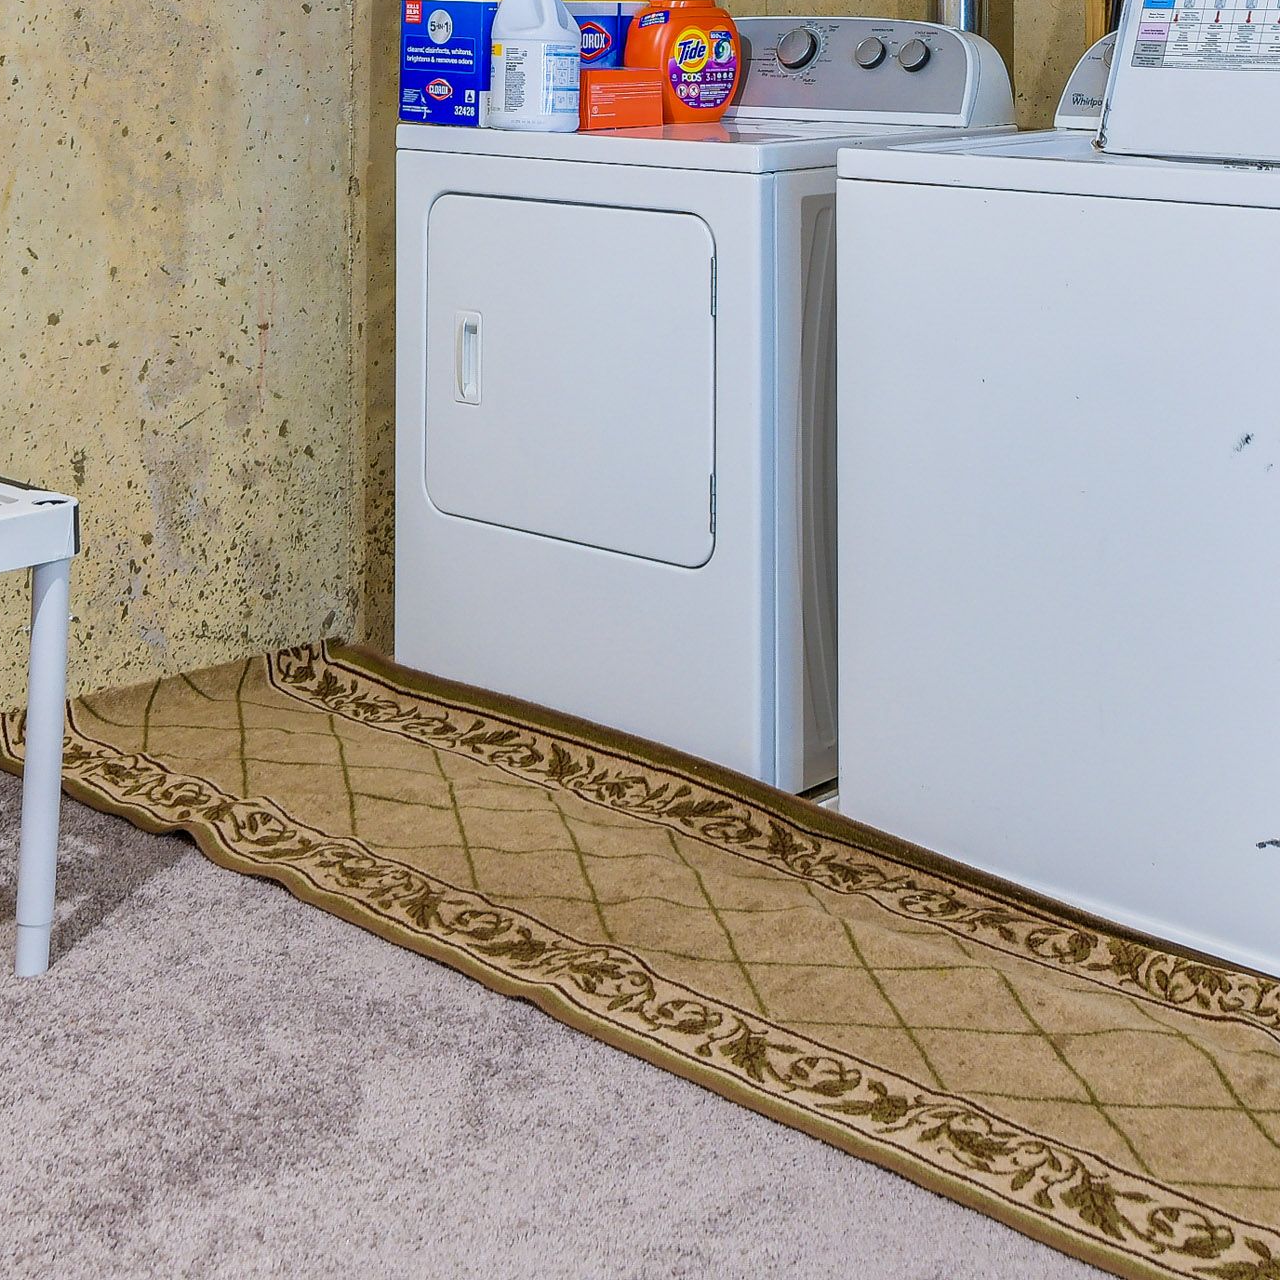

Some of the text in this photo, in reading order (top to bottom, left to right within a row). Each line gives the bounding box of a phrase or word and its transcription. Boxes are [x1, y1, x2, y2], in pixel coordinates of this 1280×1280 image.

[581, 33, 606, 49] OROX
[678, 40, 707, 66] Tide
[682, 73, 702, 82] PODS
[428, 85, 448, 94] CLOROX
[1072, 97, 1103, 108] Whirlpo
[454, 106, 475, 116] 32428
